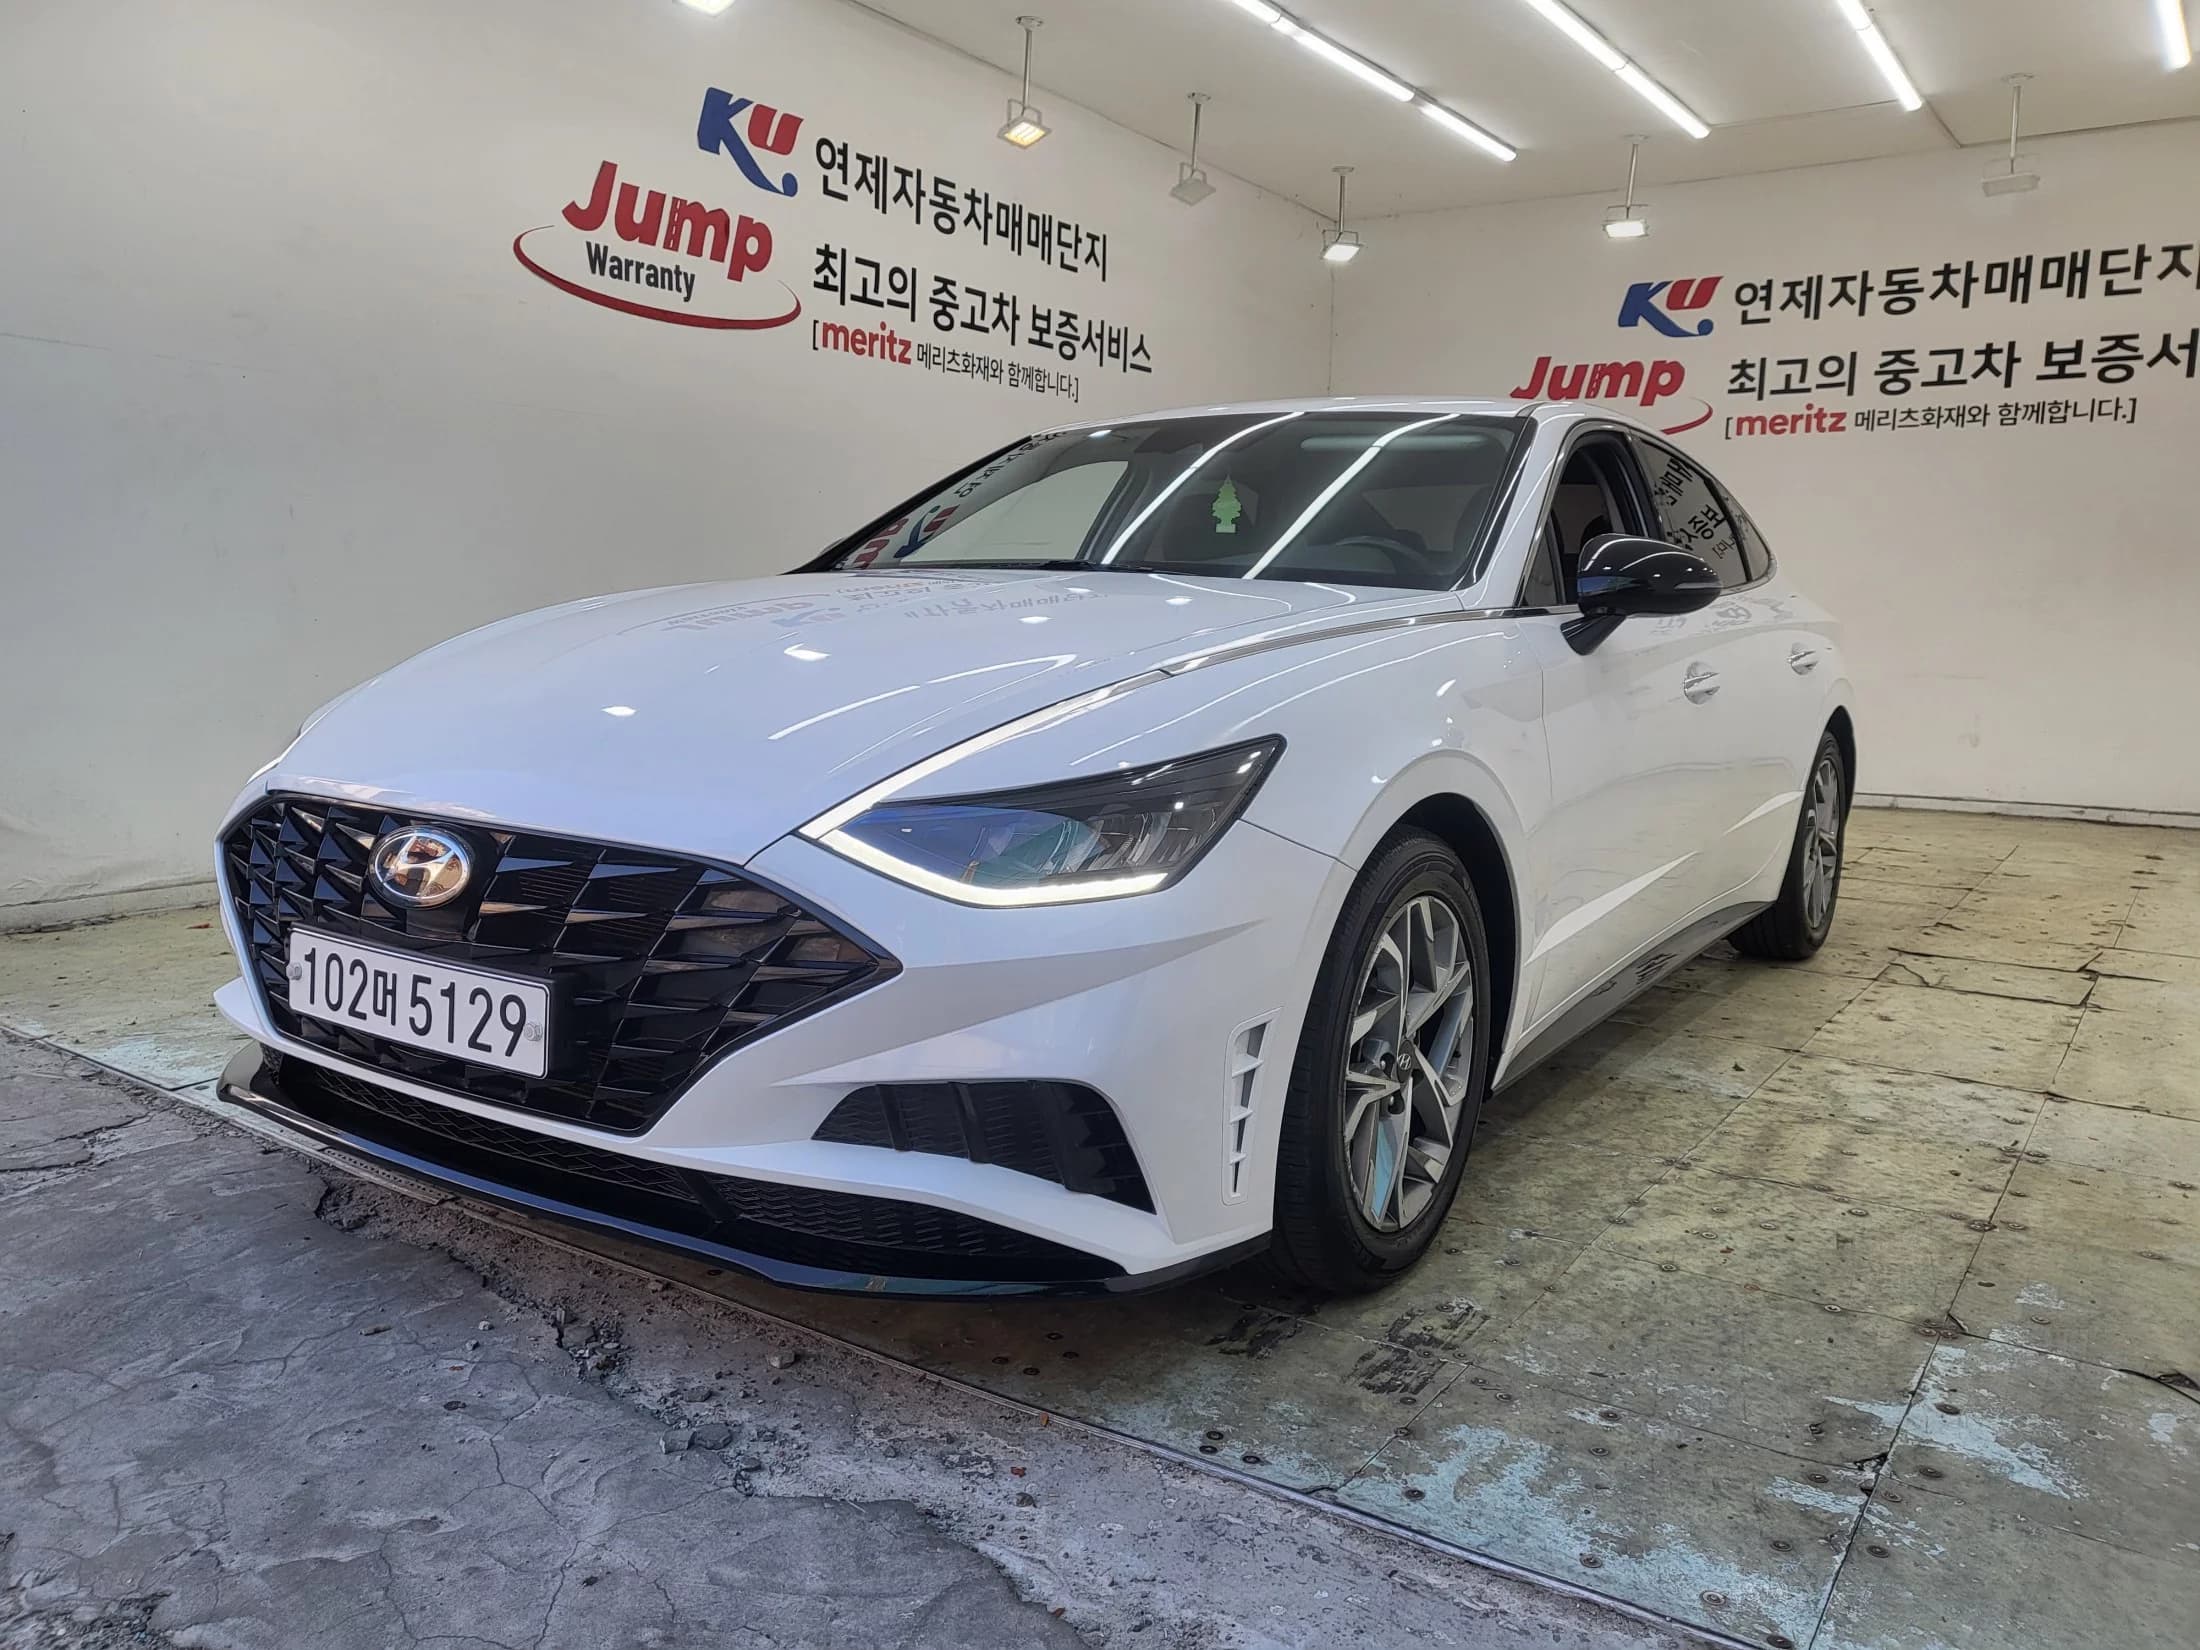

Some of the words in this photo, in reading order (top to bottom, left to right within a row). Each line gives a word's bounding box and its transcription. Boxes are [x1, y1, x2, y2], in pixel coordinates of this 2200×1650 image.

[562, 161, 772, 283] Jump
[814, 137, 1107, 283] 연제자동차매매단지
[586, 241, 695, 302] Warranty
[813, 243, 917, 323] 최고의
[929, 275, 1020, 347] 중고차
[1028, 303, 1153, 374] 보증서비스
[1734, 243, 2200, 326] 연제자동차매매단지
[916, 343, 1004, 385] 메리츠화재와
[1510, 356, 1685, 407] Jump
[1727, 351, 1858, 402] 최고의
[1873, 340, 2022, 396] 중고차
[2035, 327, 2200, 384] 보증서
[1854, 403, 1991, 432] 메리츠화재와
